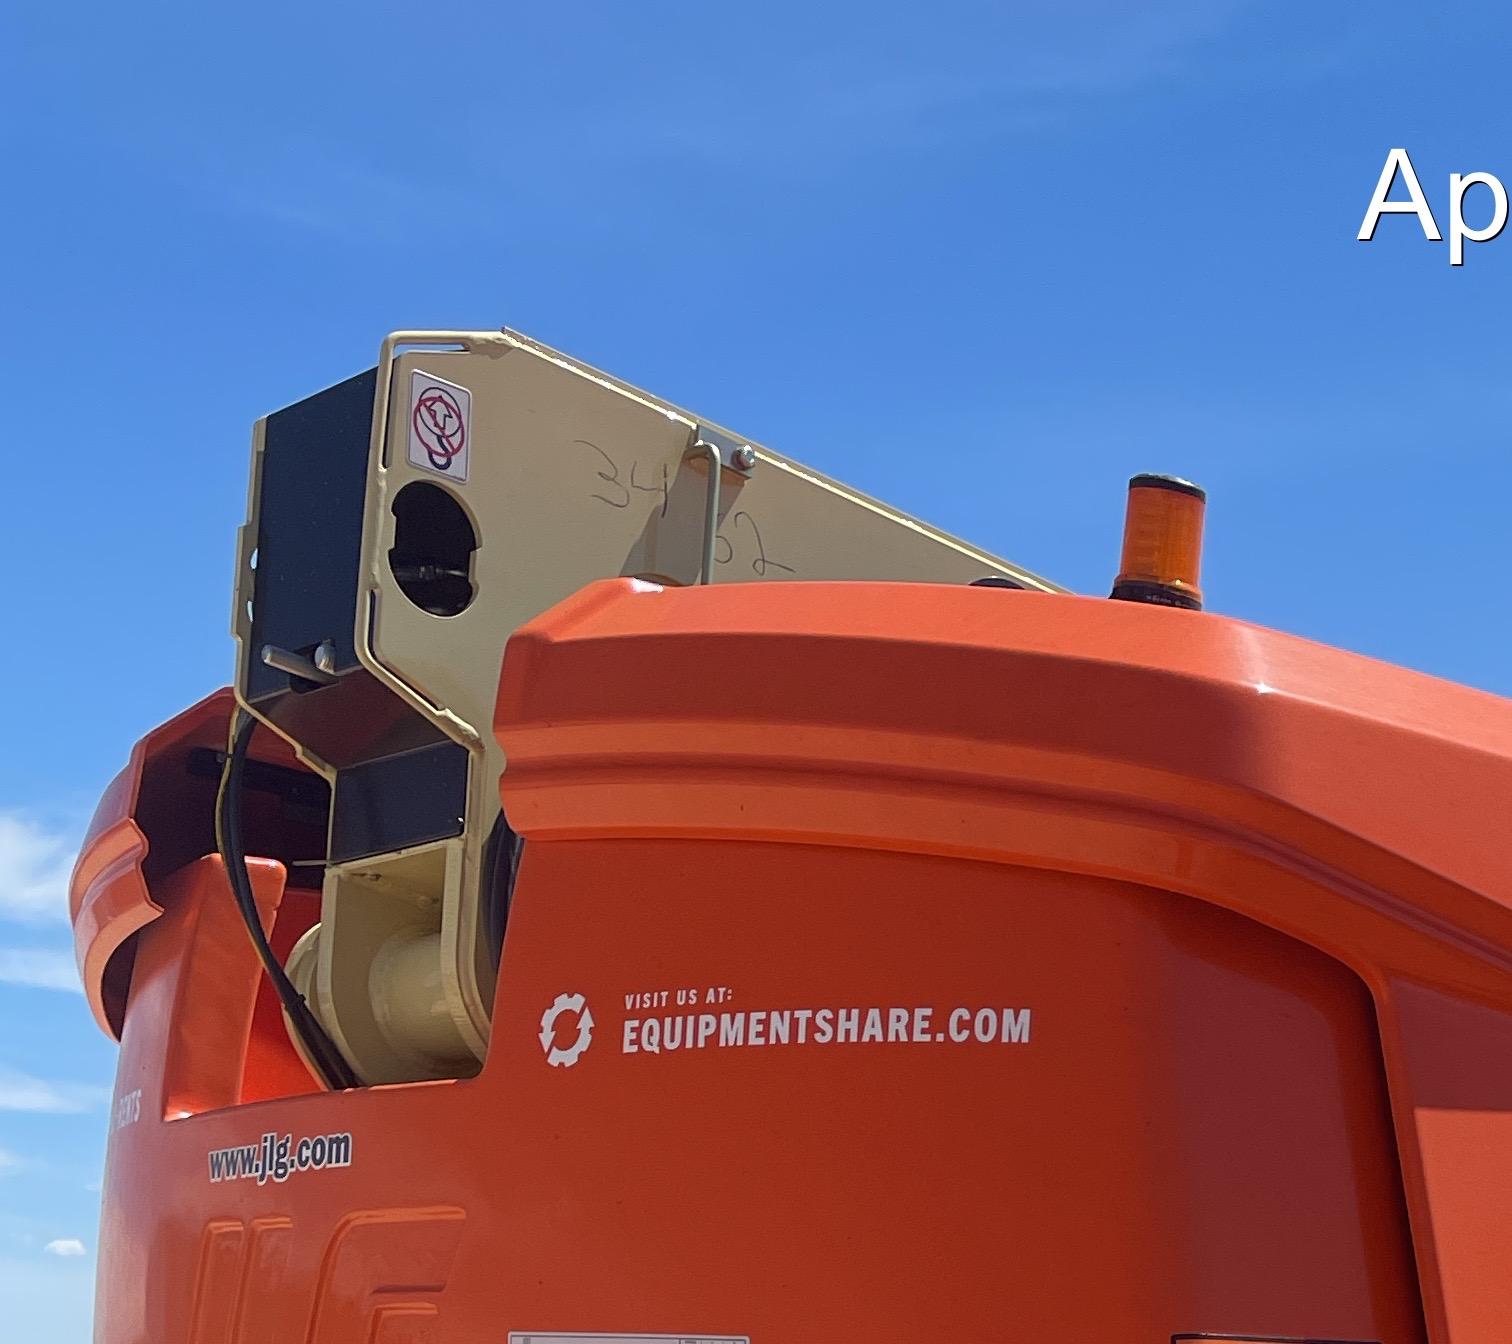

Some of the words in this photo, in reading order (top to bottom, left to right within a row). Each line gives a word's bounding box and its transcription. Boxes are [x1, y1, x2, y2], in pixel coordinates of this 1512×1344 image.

[624, 991, 670, 1010] VISIT
[676, 989, 698, 1006] US
[705, 986, 734, 1004] AT:
[622, 1007, 1032, 1054] EQUIPMENTSHARE.COM
[208, 1132, 352, 1184] www.jlg.com
